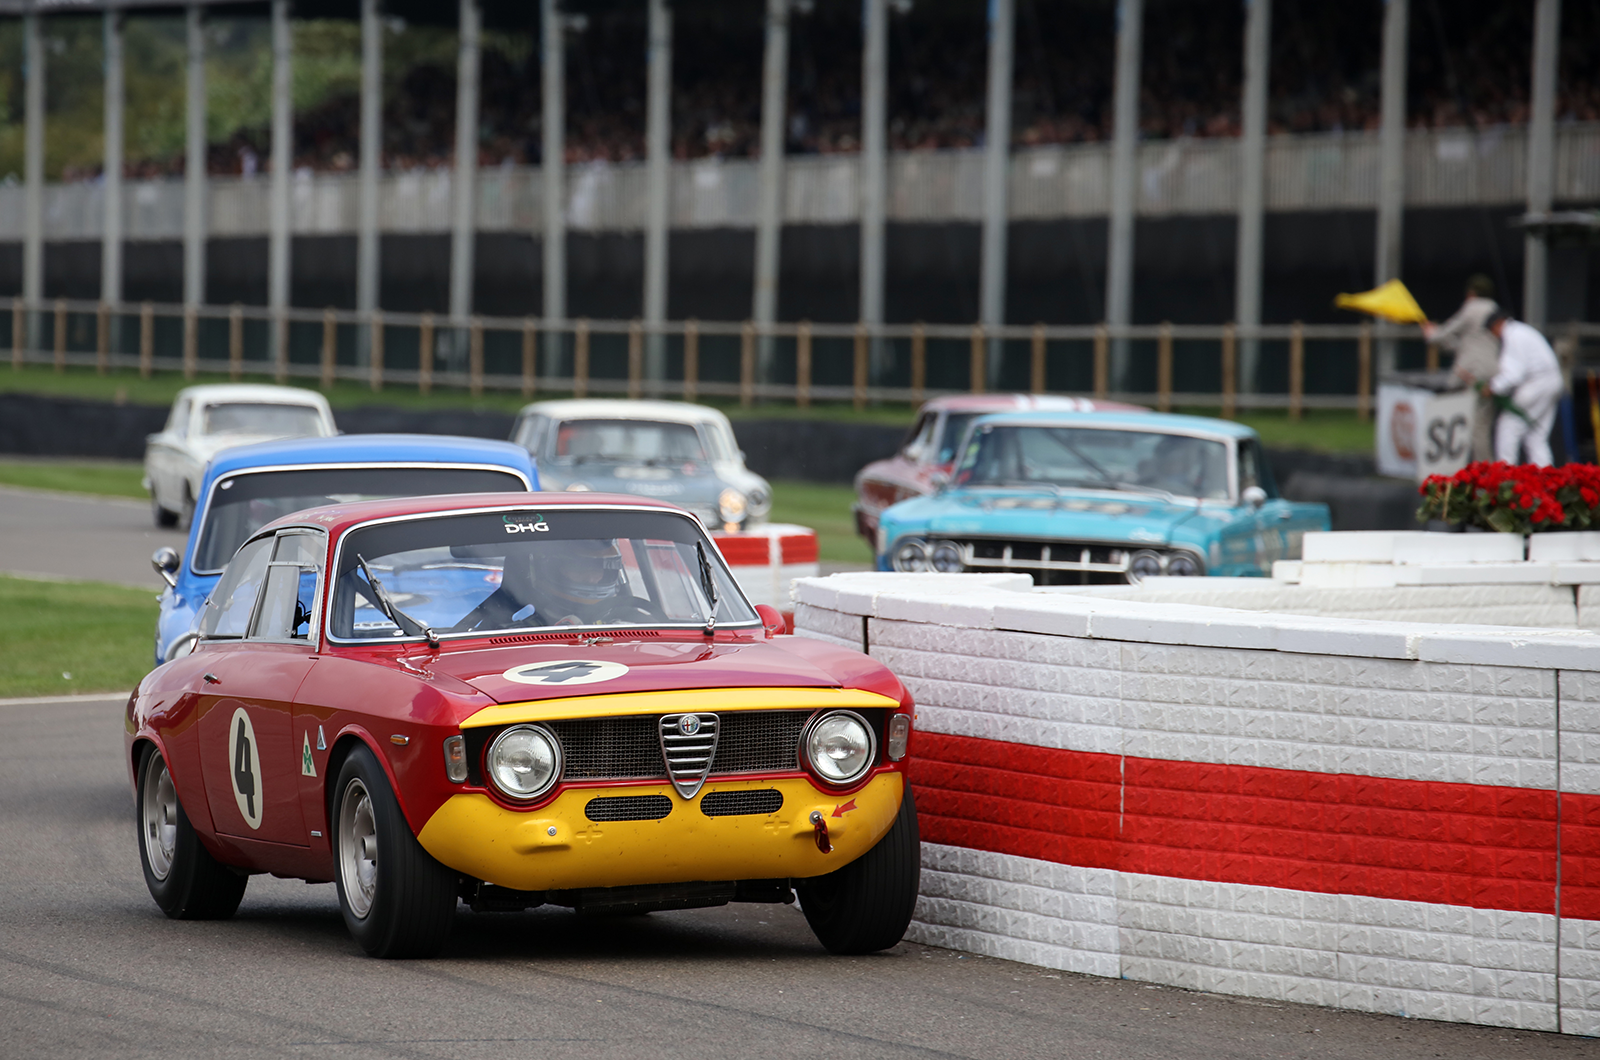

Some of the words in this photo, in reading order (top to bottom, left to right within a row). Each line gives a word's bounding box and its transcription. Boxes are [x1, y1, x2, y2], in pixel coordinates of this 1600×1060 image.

[1425, 414, 1467, 464] SC
[504, 522, 549, 534] DHG
[517, 661, 602, 682] 4
[234, 717, 256, 819] 4
